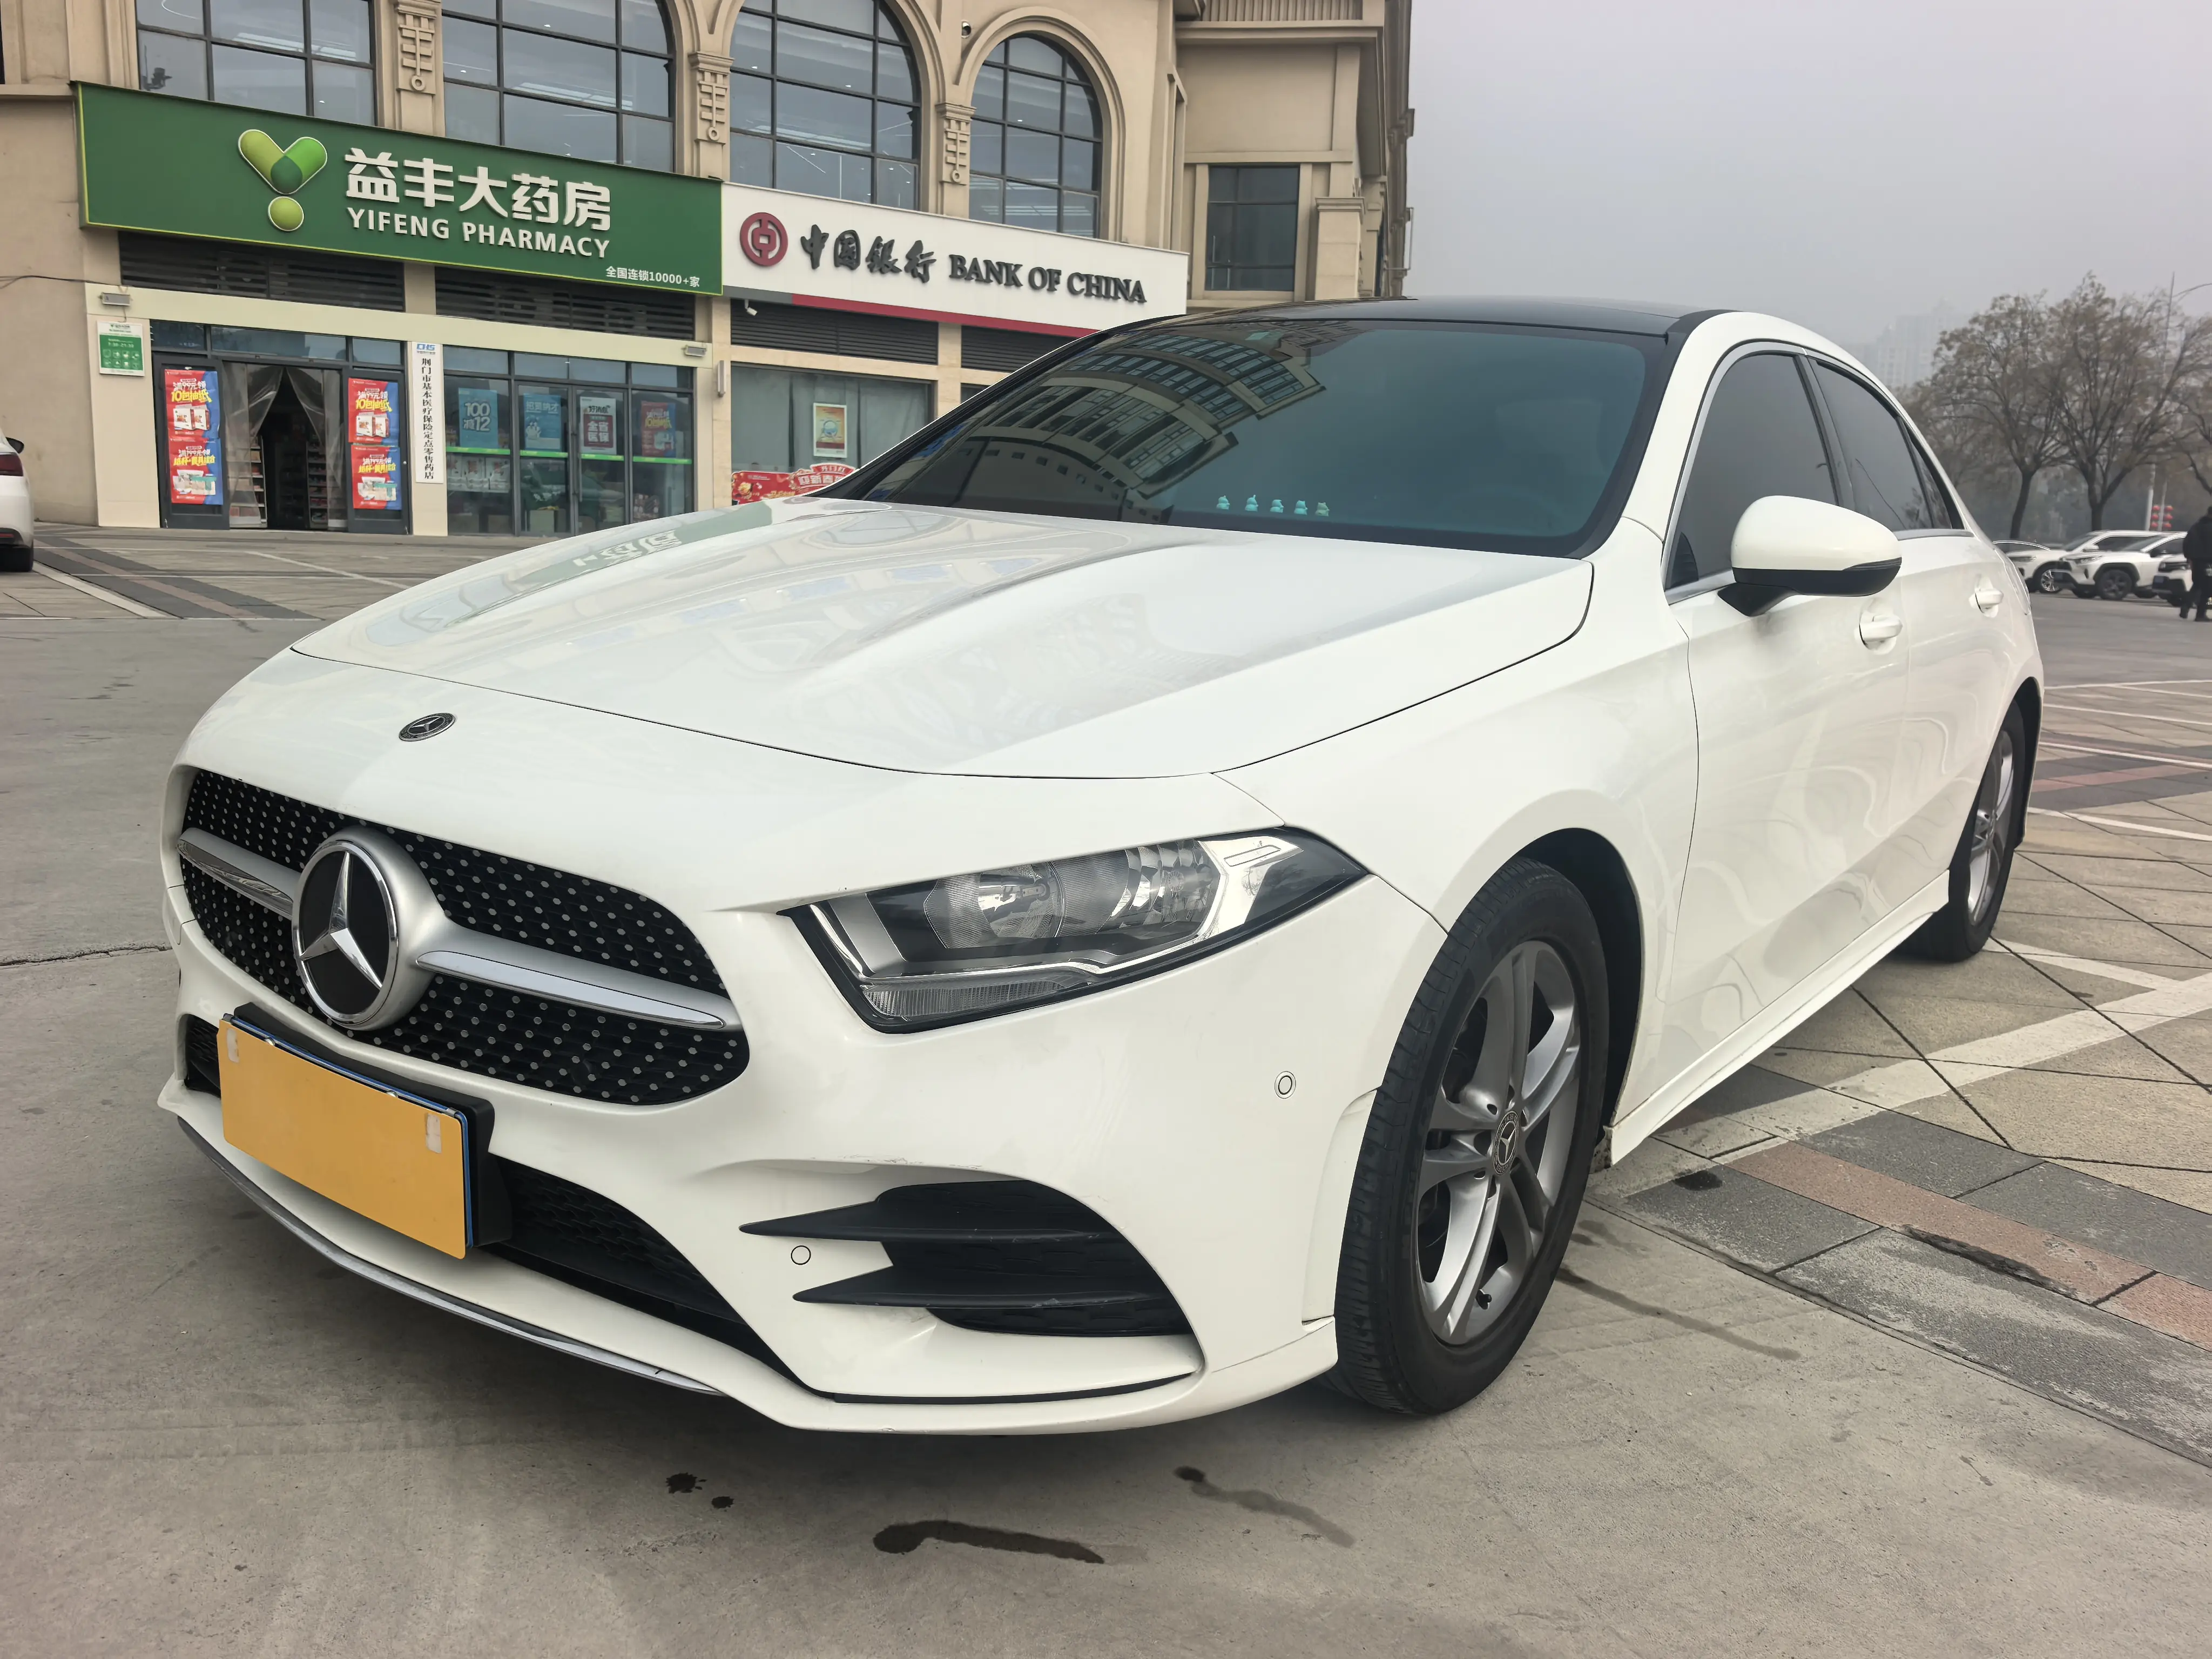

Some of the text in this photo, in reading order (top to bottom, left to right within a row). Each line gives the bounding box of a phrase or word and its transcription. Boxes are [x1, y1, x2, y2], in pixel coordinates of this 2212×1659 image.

[345, 147, 611, 231] 益丰大药房
[347, 207, 610, 258] YIFENG PHARMACY
[800, 224, 937, 283] 中国银行
[606, 266, 700, 288] 全国连锁10000+家
[949, 254, 1147, 303] BANK OF CHINA
[464, 402, 490, 417] 100
